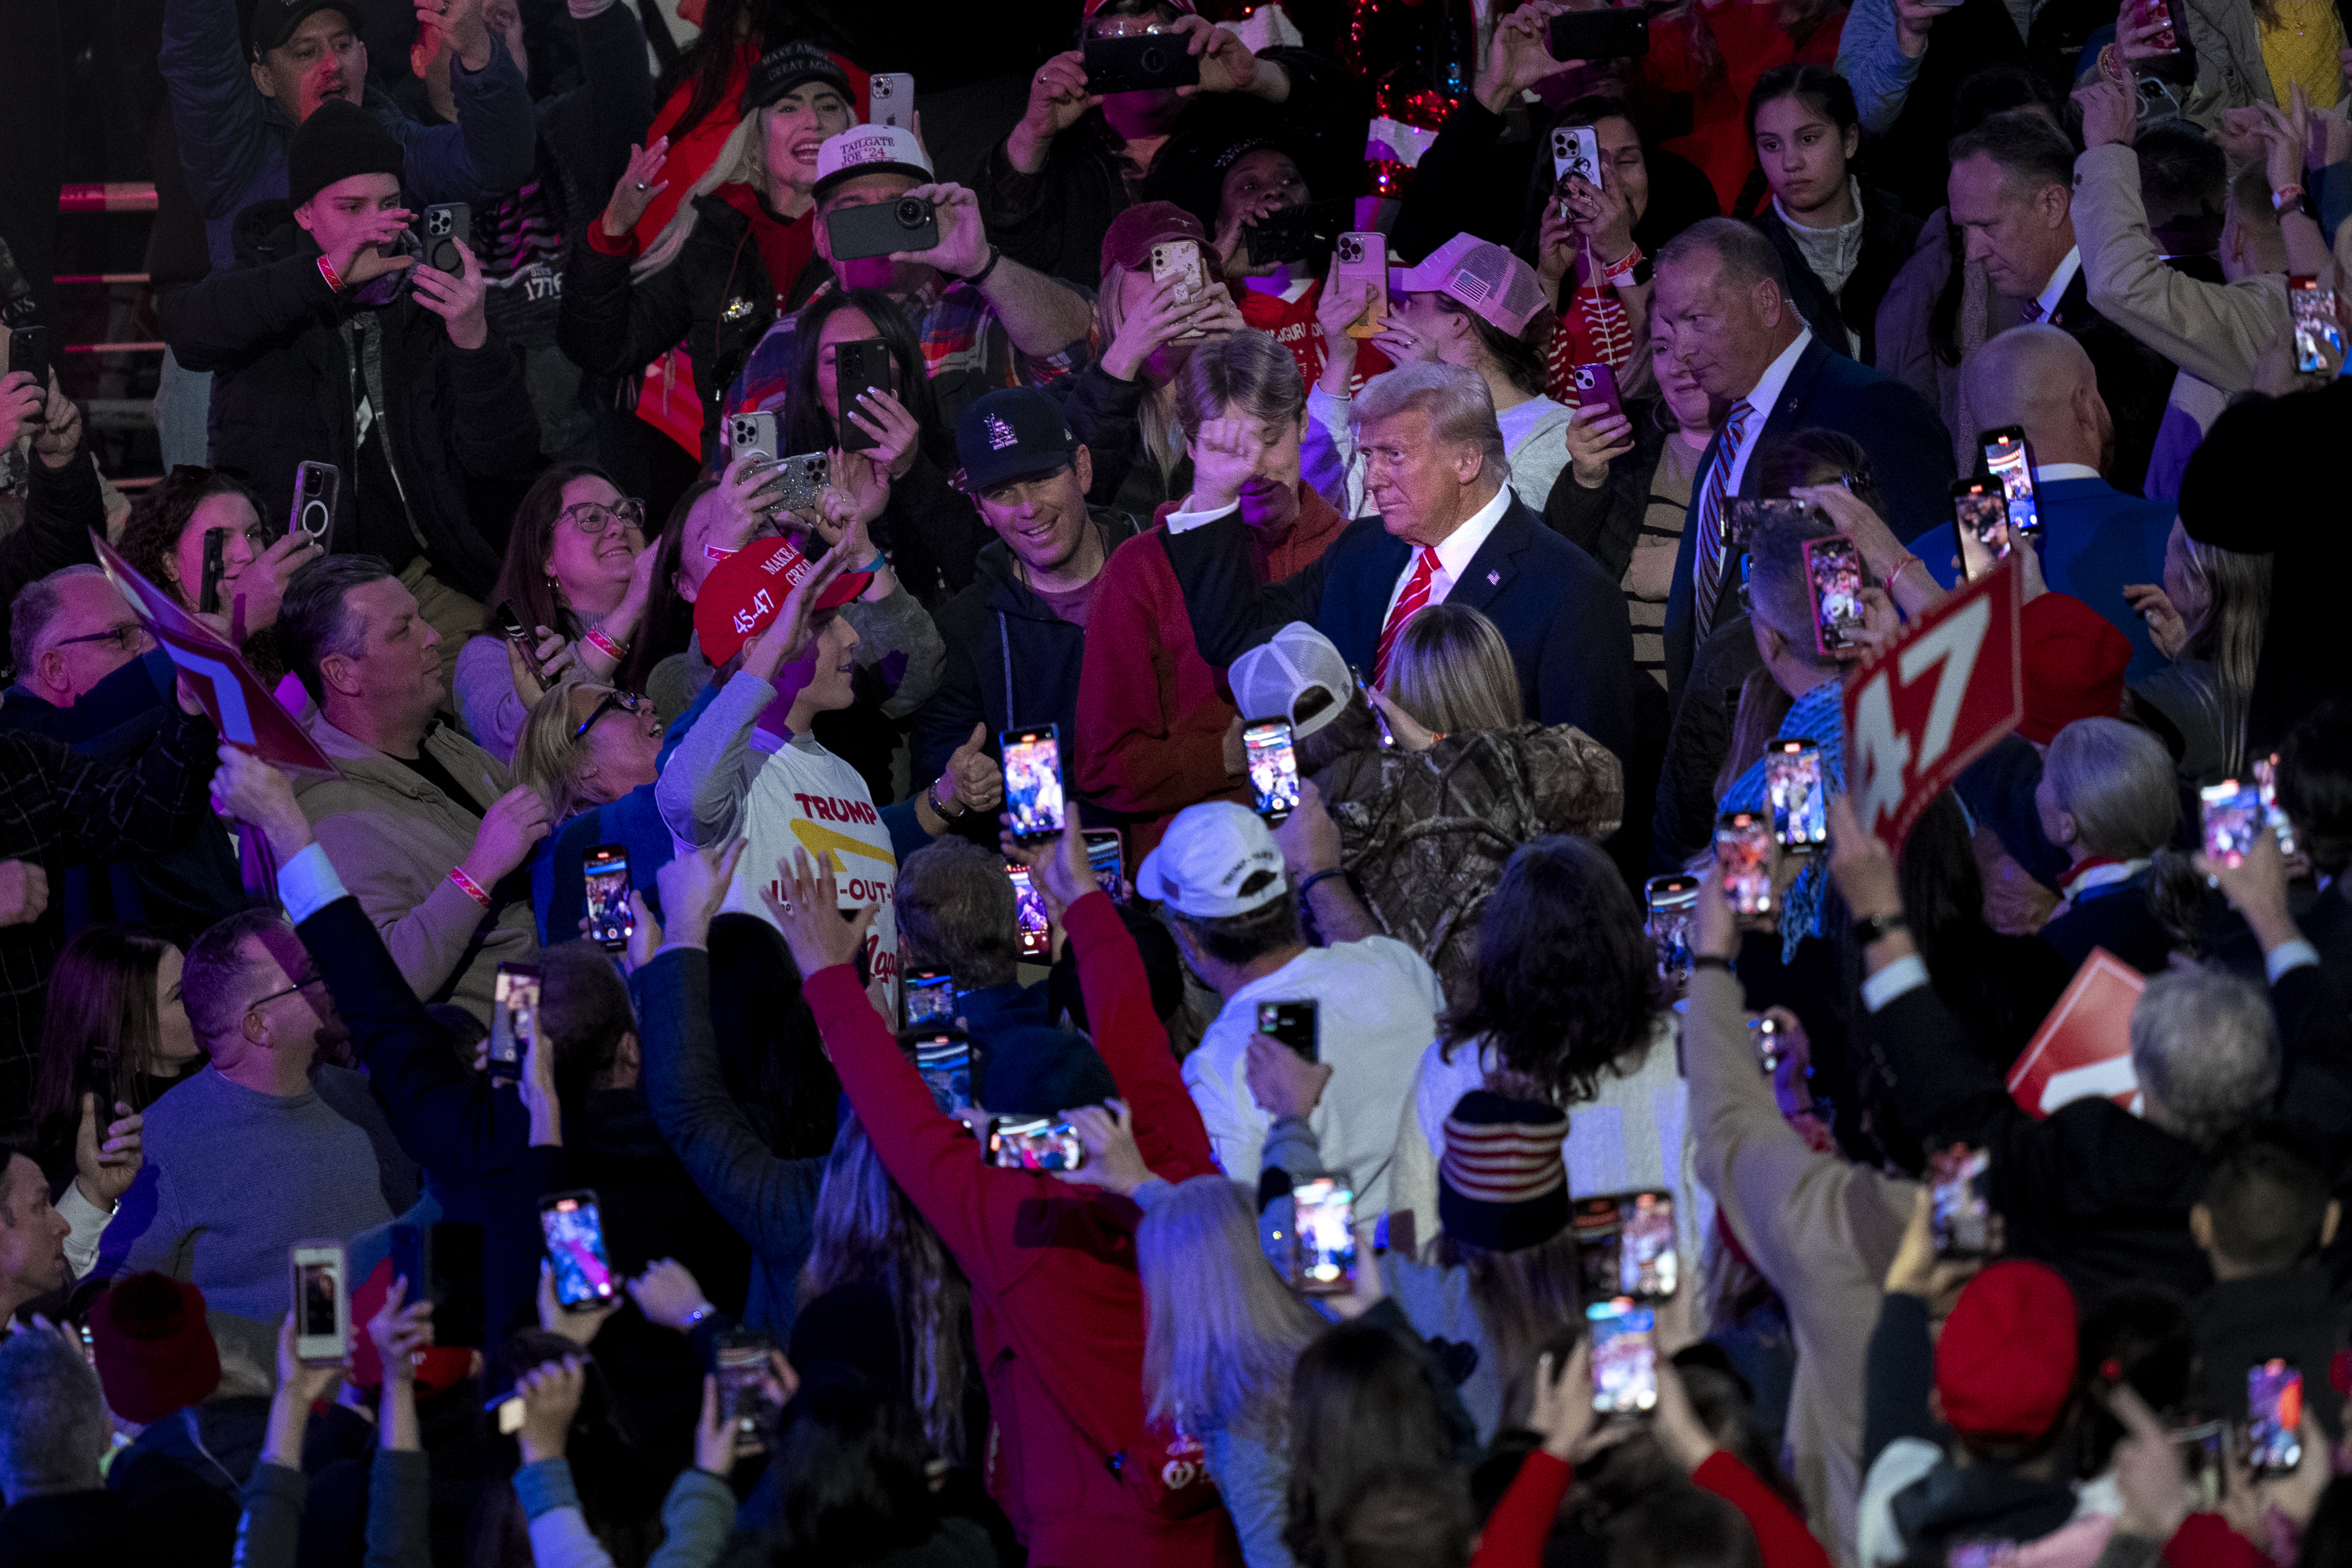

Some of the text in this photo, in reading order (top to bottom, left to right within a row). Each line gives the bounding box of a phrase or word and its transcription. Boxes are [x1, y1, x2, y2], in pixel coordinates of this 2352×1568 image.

[840, 138, 895, 154] TAILGATE
[841, 152, 863, 163] JOE
[760, 546, 796, 576] MAKE
[733, 587, 775, 634] 45-47
[1853, 591, 1992, 834] 47
[794, 793, 877, 825] TRUMP
